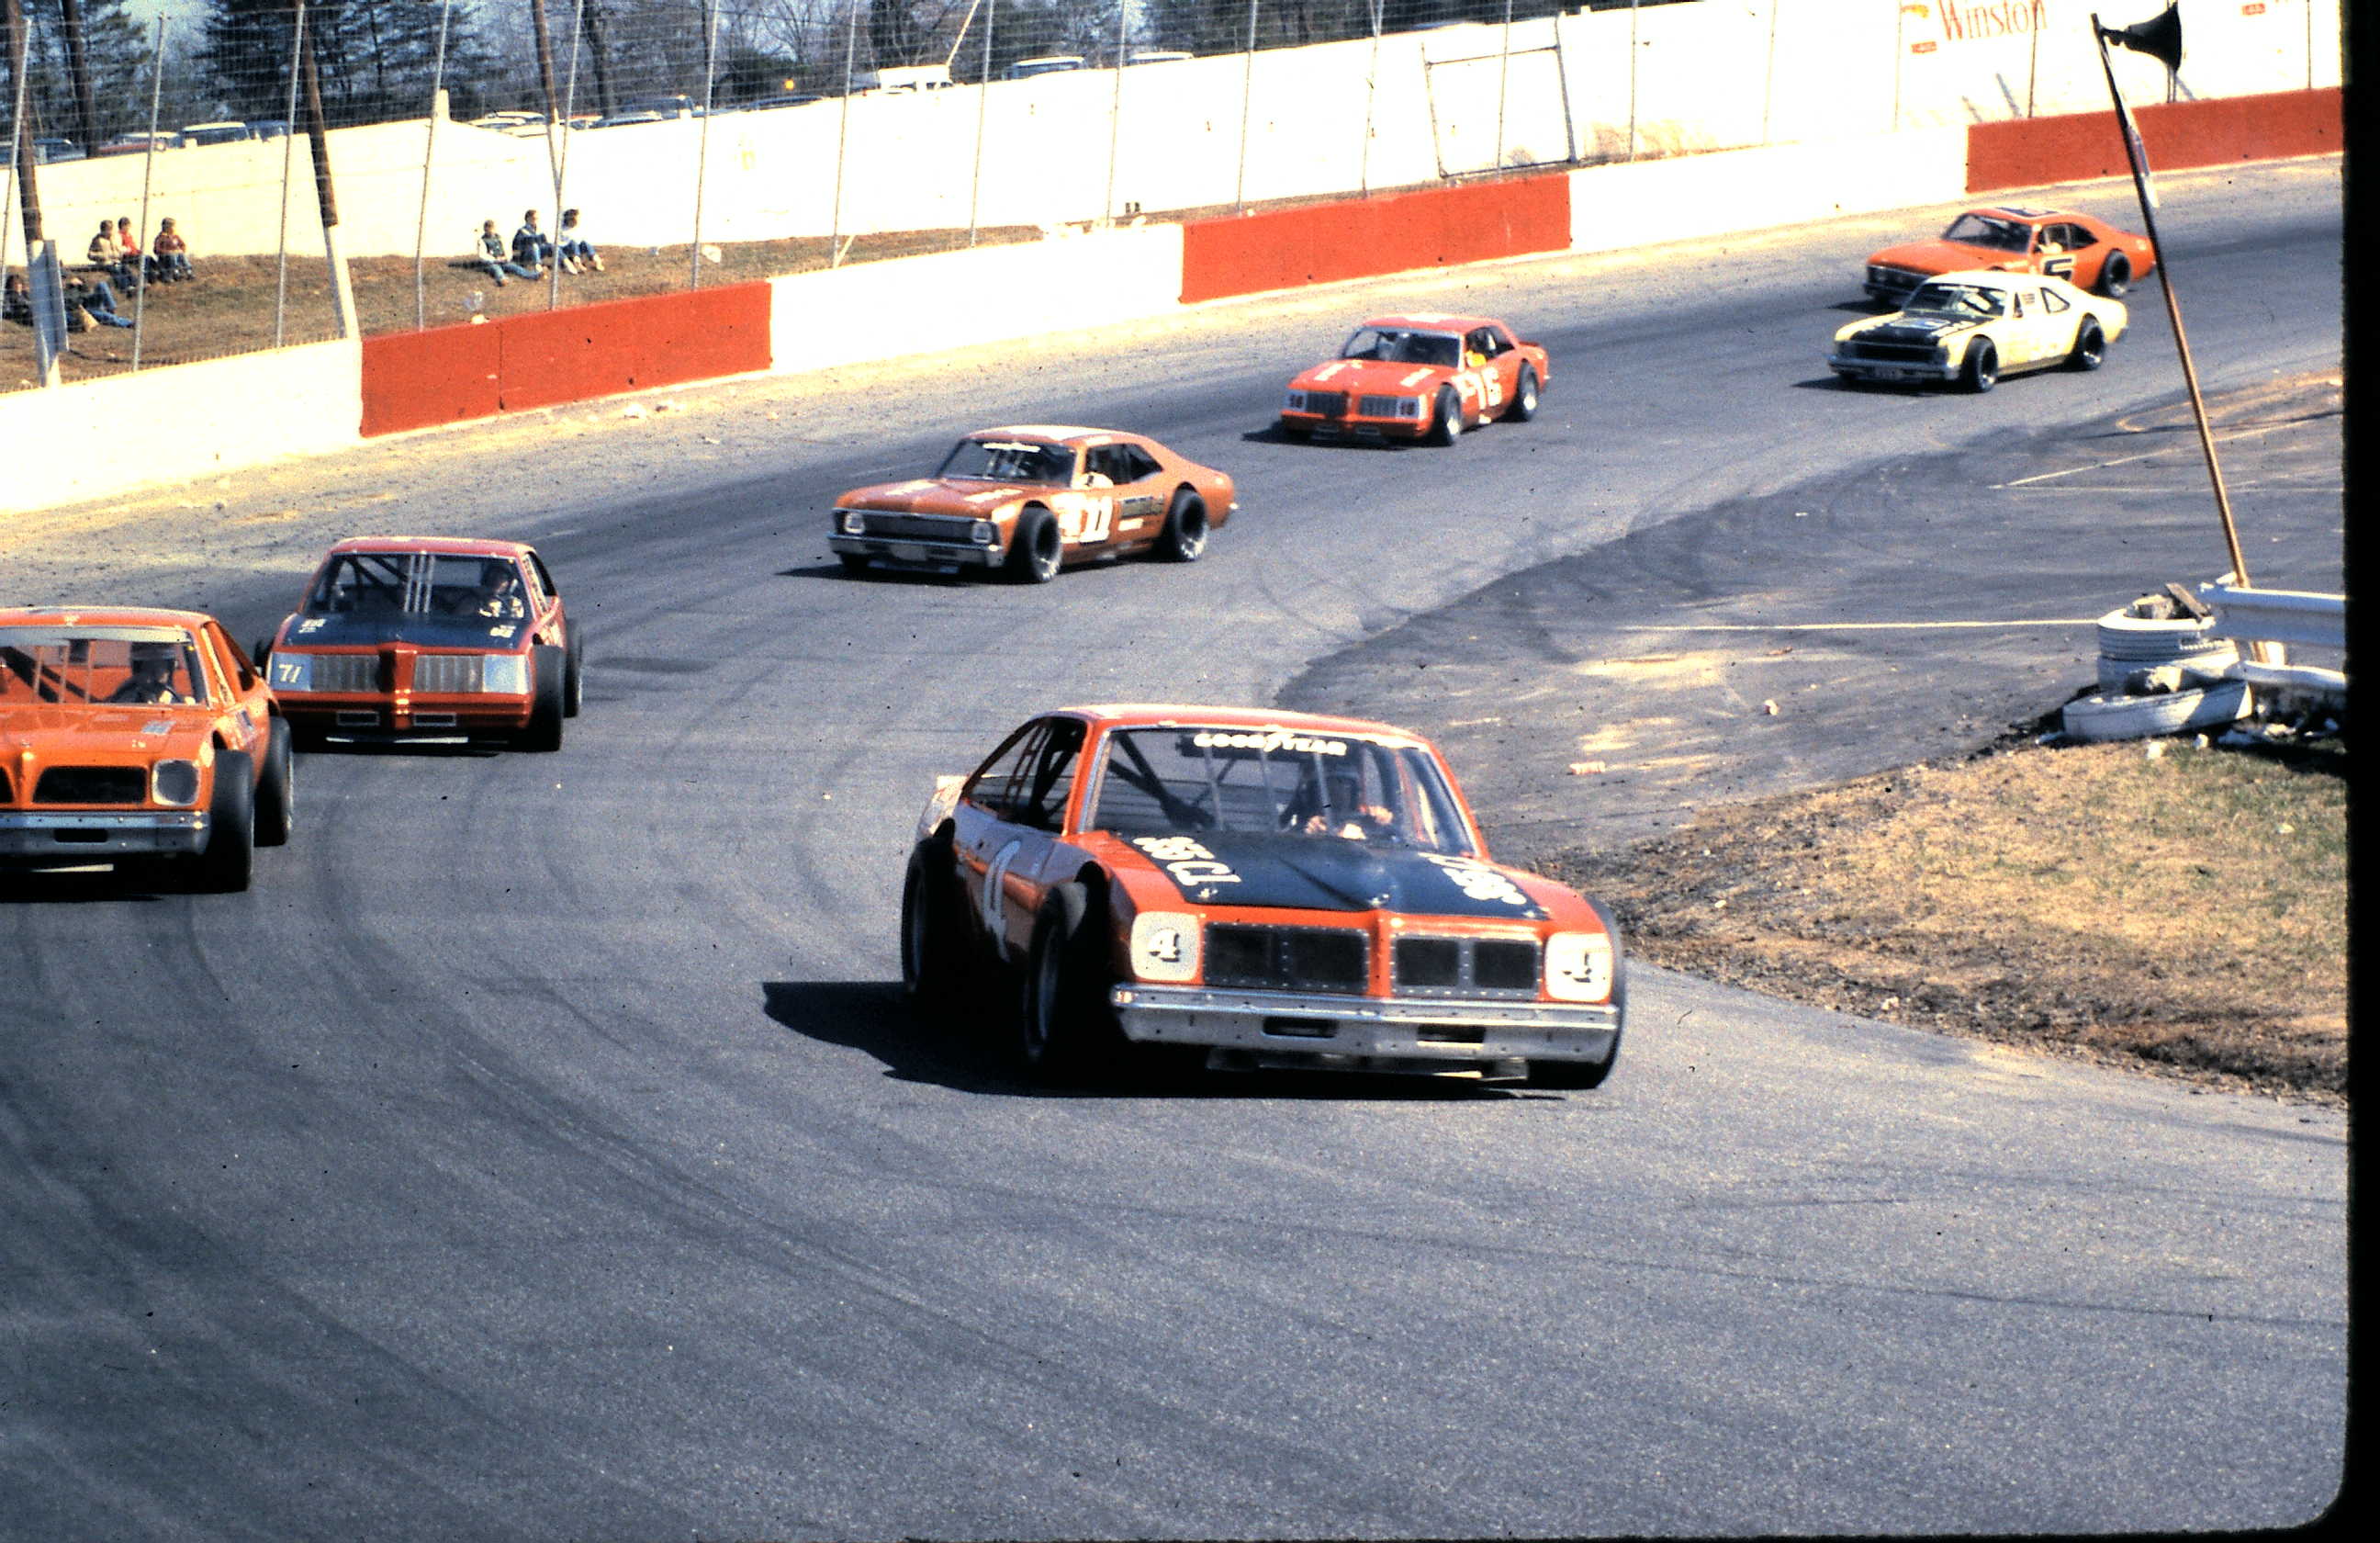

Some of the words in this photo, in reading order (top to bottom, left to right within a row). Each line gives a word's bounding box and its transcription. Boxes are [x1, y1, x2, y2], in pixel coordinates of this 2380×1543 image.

[1936, 0, 2049, 41] Winston
[278, 664, 302, 683] 71
[1147, 928, 1181, 963] 4
